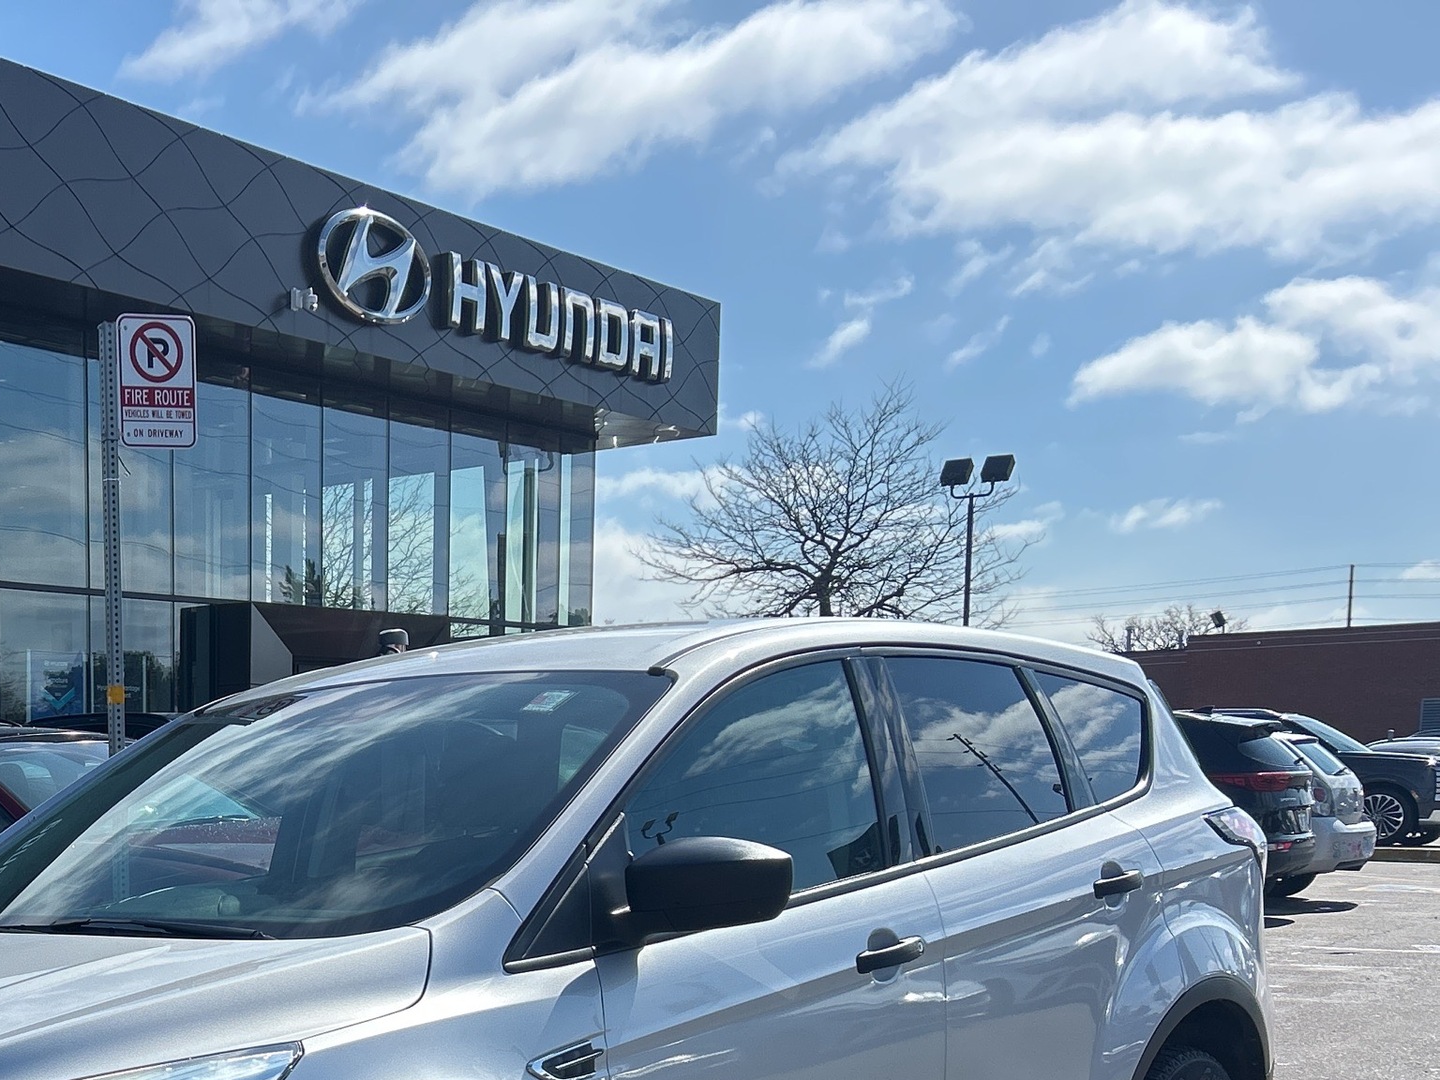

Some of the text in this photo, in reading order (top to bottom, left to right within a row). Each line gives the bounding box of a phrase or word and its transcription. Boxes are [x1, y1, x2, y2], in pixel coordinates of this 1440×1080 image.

[447, 250, 674, 384] HYUNDAI
[124, 388, 191, 406] FIRE ROUTE
[124, 409, 192, 420] VEHICLES WILL BE TOWED
[133, 428, 184, 439] ON DRIVEWAY
